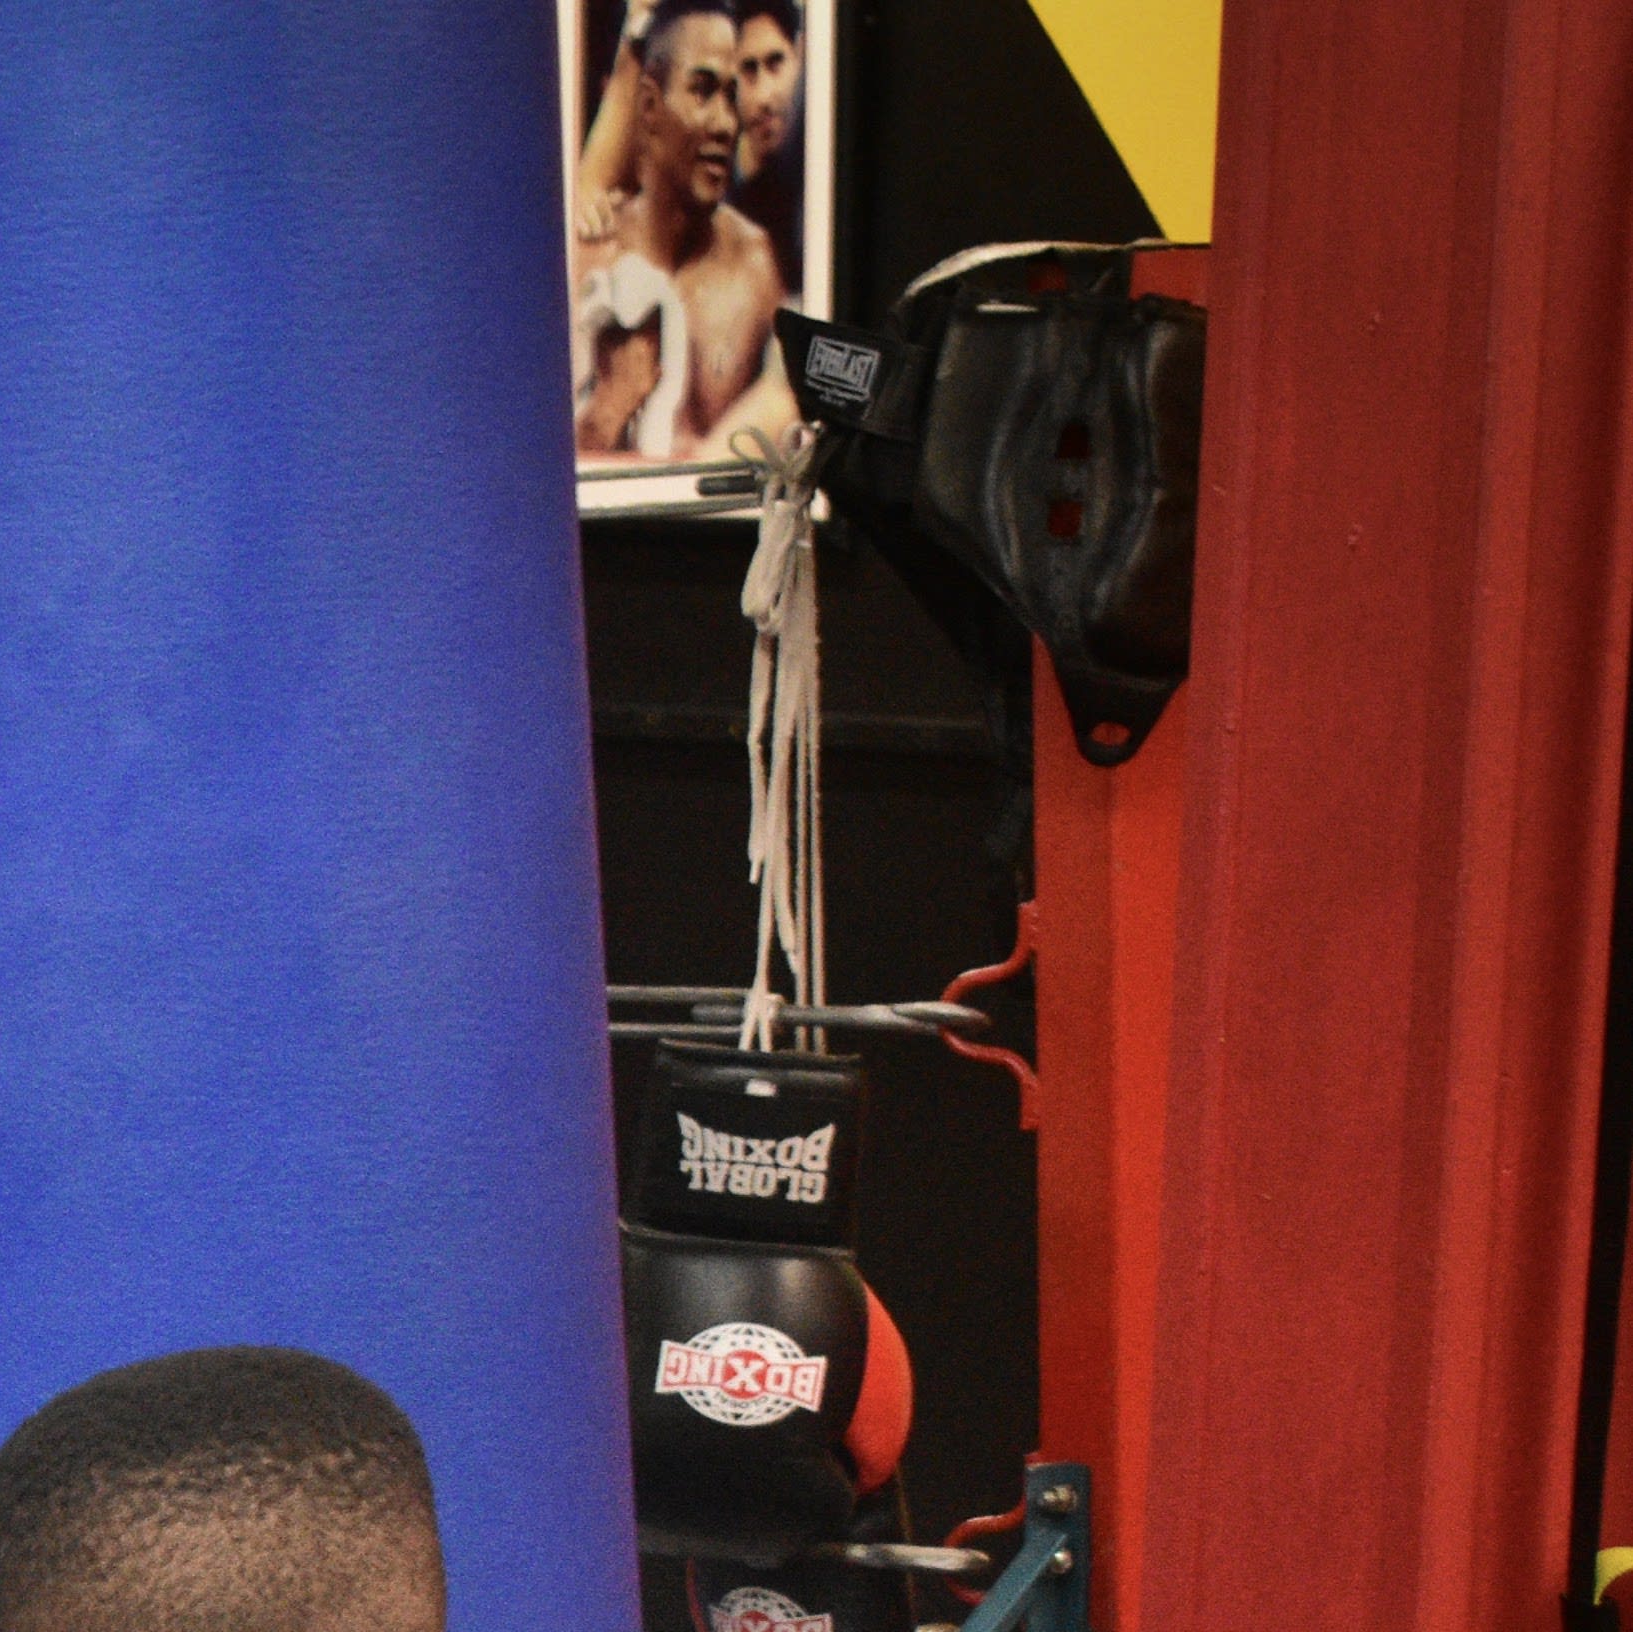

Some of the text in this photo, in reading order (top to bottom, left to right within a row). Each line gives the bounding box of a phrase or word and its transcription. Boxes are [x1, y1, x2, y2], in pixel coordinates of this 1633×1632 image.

[676, 1111, 837, 1171] BOXING
[680, 1160, 827, 1205] GLOBAL
[665, 1351, 818, 1402] BOXING
